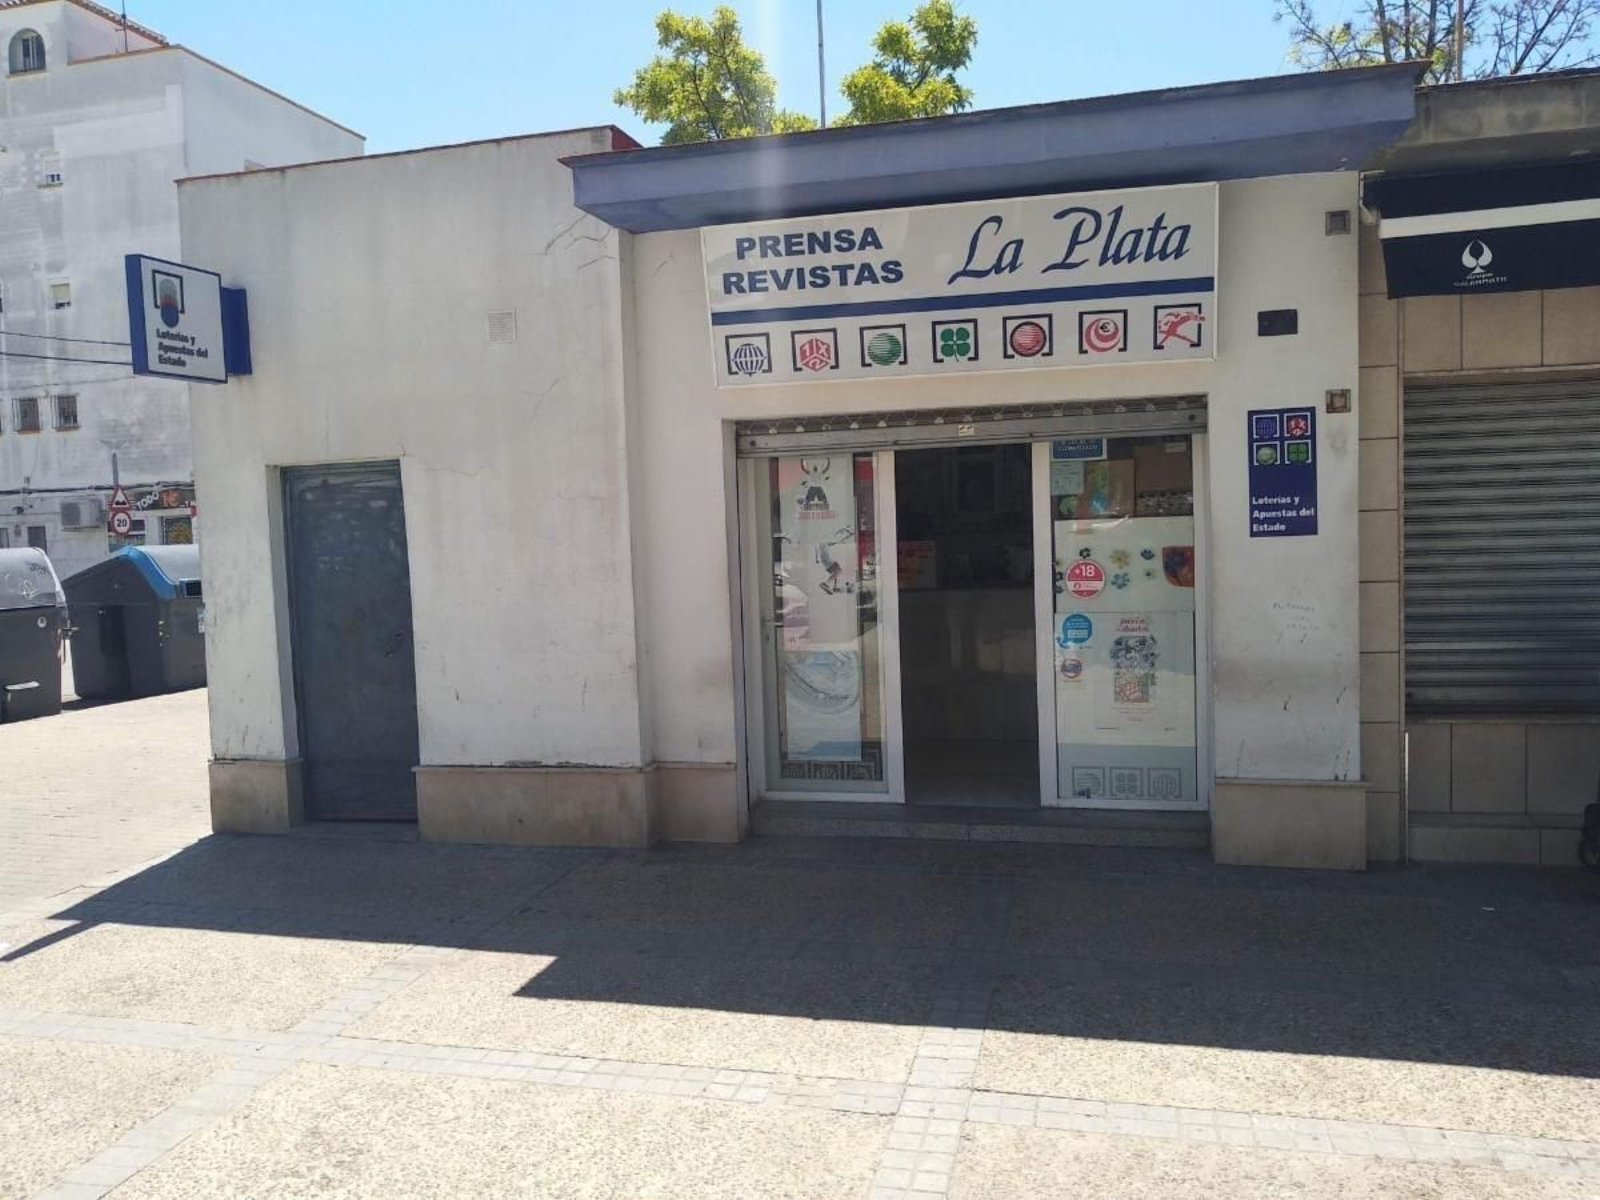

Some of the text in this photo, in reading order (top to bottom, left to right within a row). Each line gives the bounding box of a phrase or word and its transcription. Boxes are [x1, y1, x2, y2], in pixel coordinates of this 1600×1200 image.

[735, 227, 883, 260] PRENSA
[947, 204, 1191, 285] La Plata
[722, 260, 904, 295] REVISTAS
[158, 341, 208, 358] Apuestas del
[158, 354, 187, 367] Estado
[136, 491, 160, 510] TODO
[1293, 496, 1300, 505] y
[1252, 507, 1314, 520] Apuestas del
[116, 518, 127, 527] 20
[1252, 522, 1286, 532] Estado
